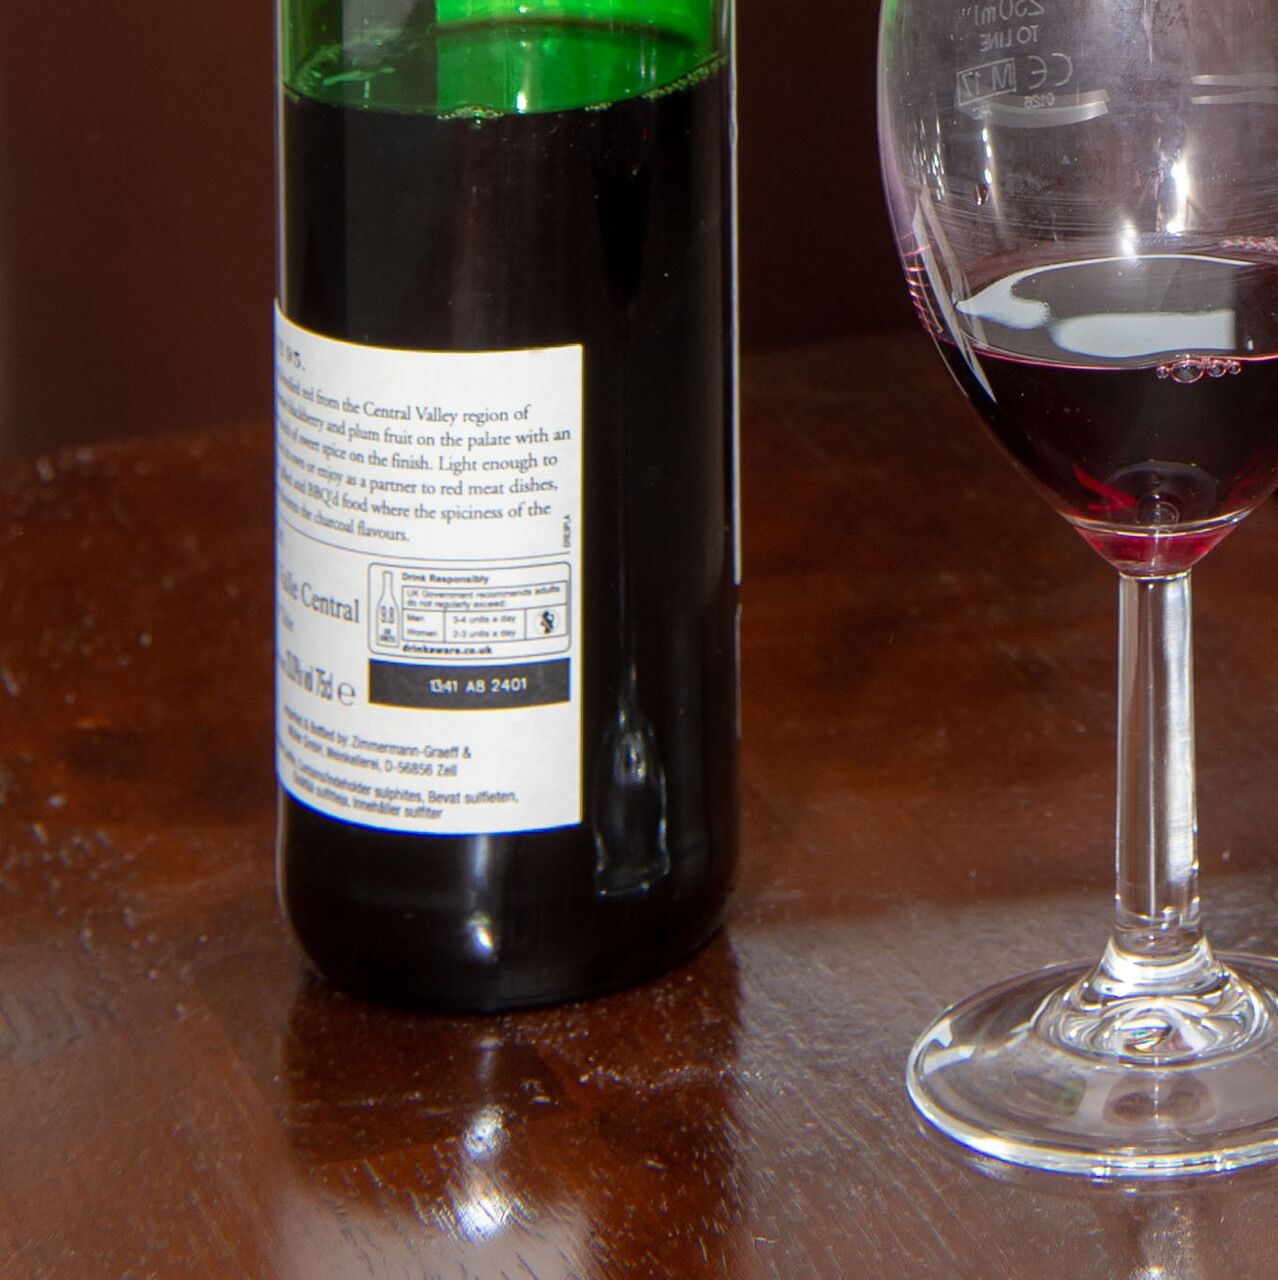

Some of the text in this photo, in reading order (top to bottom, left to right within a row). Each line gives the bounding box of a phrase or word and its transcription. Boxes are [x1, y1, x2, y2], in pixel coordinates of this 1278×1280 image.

[342, 397, 360, 414] the
[363, 400, 412, 421] Central
[416, 405, 459, 426] Valley
[463, 407, 509, 428] region
[513, 403, 532, 421] of
[326, 420, 346, 436] and
[348, 422, 380, 442] plum
[384, 426, 413, 446] fruit
[417, 434, 436, 446] on
[440, 431, 463, 447] the
[467, 430, 512, 452] palate
[515, 427, 549, 445] with
[553, 428, 572, 442] an
[322, 442, 347, 461] spice
[349, 451, 365, 463] on
[368, 449, 389, 467] the
[391, 452, 433, 471] finish.
[438, 455, 478, 476] Light
[482, 452, 539, 474] enough
[542, 454, 559, 467] to
[317, 465, 345, 486] enjoy
[346, 475, 358, 487] as
[360, 477, 368, 488] a
[370, 478, 417, 495] partner
[421, 481, 437, 495] to
[440, 479, 464, 496] red
[468, 483, 505, 496] meat
[508, 476, 560, 495] dishes,
[342, 491, 368, 513] food
[371, 500, 411, 519] where
[414, 501, 437, 519] the
[440, 503, 503, 525] spiciness
[508, 500, 527, 518] of
[528, 500, 553, 517] the
[357, 519, 411, 541] flavours.
[401, 571, 490, 586] Drink Responsibly
[301, 581, 360, 624] Central
[422, 590, 475, 600] Government
[419, 599, 433, 608] not
[469, 614, 490, 624] units
[500, 613, 517, 625] day
[469, 629, 490, 639] units
[500, 628, 517, 640] day
[402, 644, 493, 656] drinkaware.co.uk
[490, 677, 528, 692] 2401
[337, 681, 357, 706] e
[462, 746, 473, 760] &
[437, 763, 458, 777] Zell
[428, 789, 461, 804] Bevat
